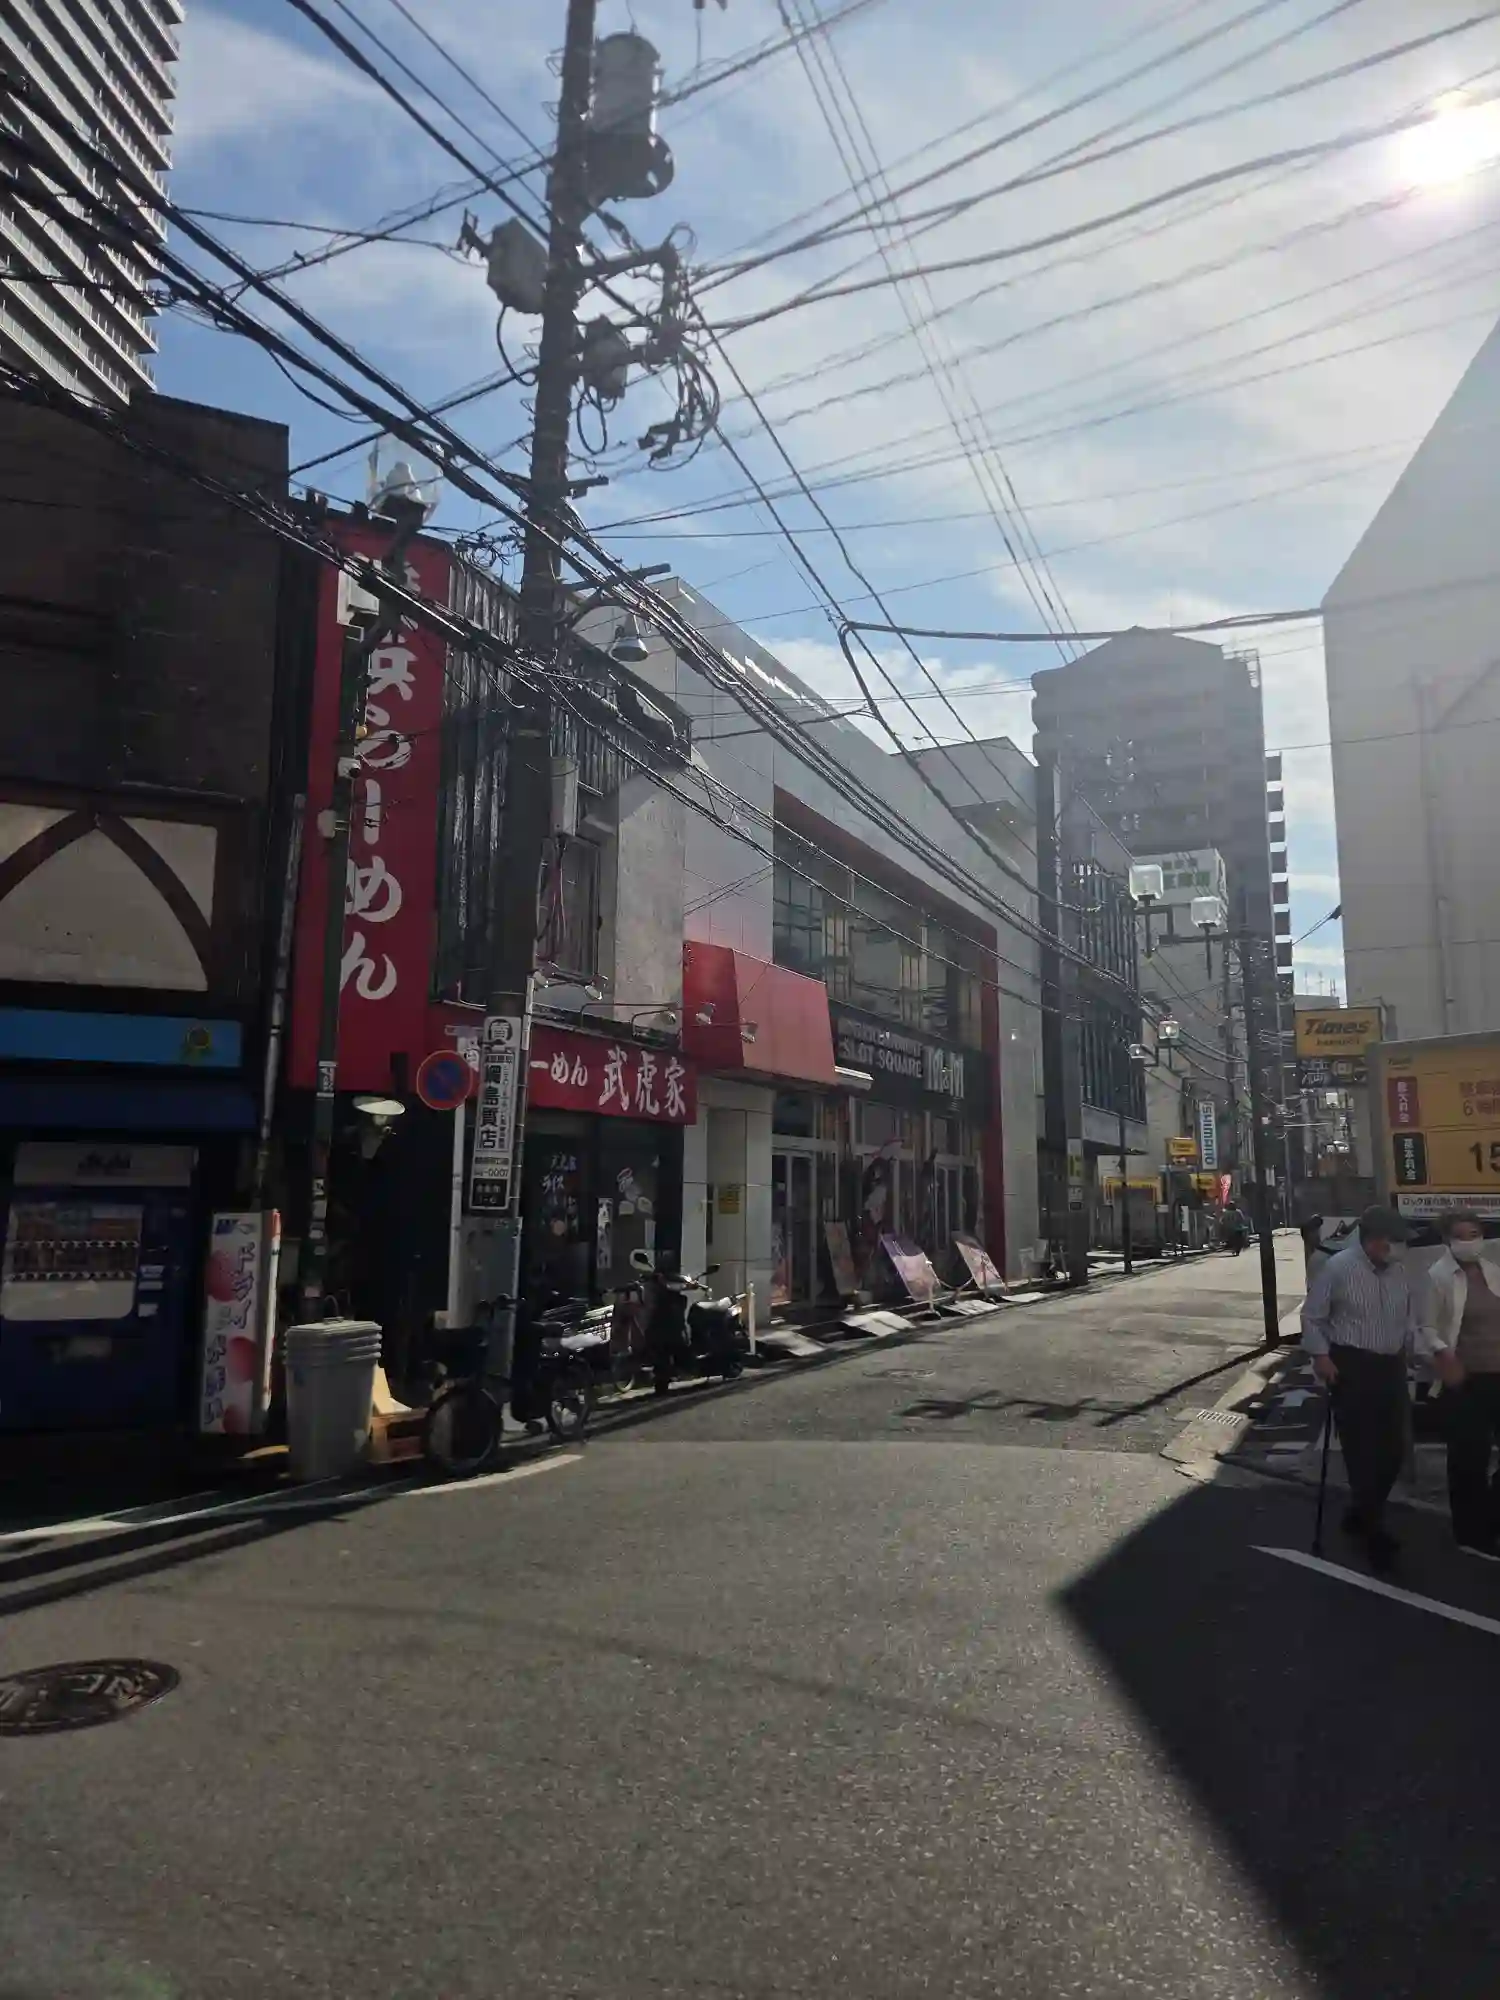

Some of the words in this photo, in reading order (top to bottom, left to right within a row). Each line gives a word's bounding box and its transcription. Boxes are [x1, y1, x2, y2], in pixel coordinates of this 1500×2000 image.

[1304, 1018, 1371, 1036] Times
[839, 1039, 875, 1066] SLOT
[878, 1050, 924, 1079] SQUARE
[598, 1043, 687, 1118] 武虎家
